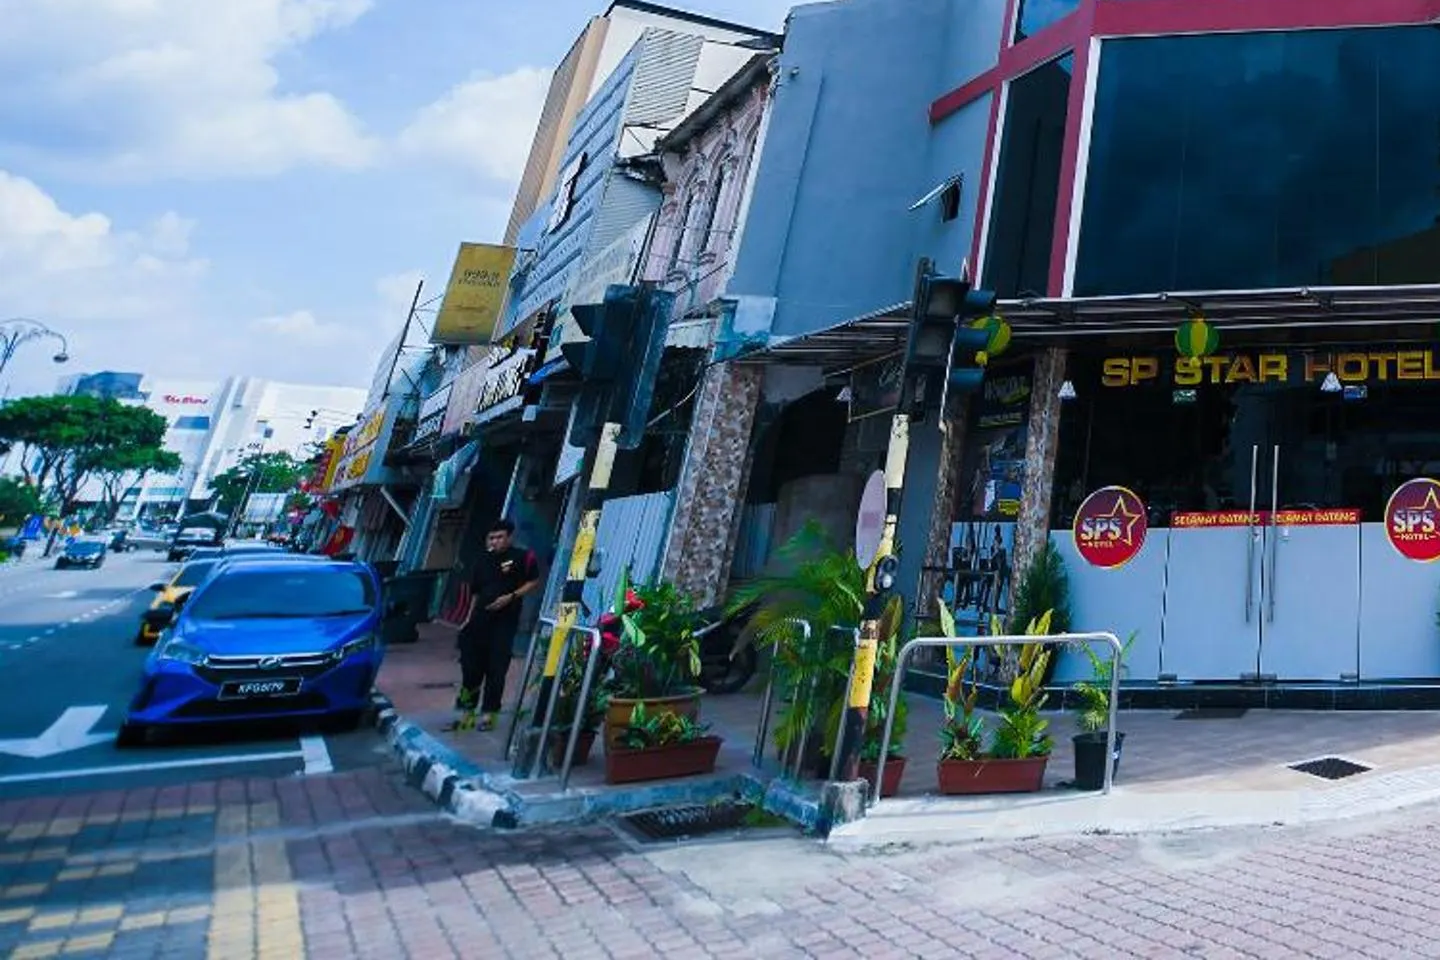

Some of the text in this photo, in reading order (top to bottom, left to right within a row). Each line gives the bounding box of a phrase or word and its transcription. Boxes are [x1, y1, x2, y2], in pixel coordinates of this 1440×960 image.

[1102, 357, 1158, 387] SP
[1174, 354, 1288, 385] STAR
[1174, 515, 1217, 525] SELAMAT
[1315, 512, 1356, 522] DATANG
[1393, 510, 1435, 533] SPS
[1081, 518, 1121, 540] SPS
